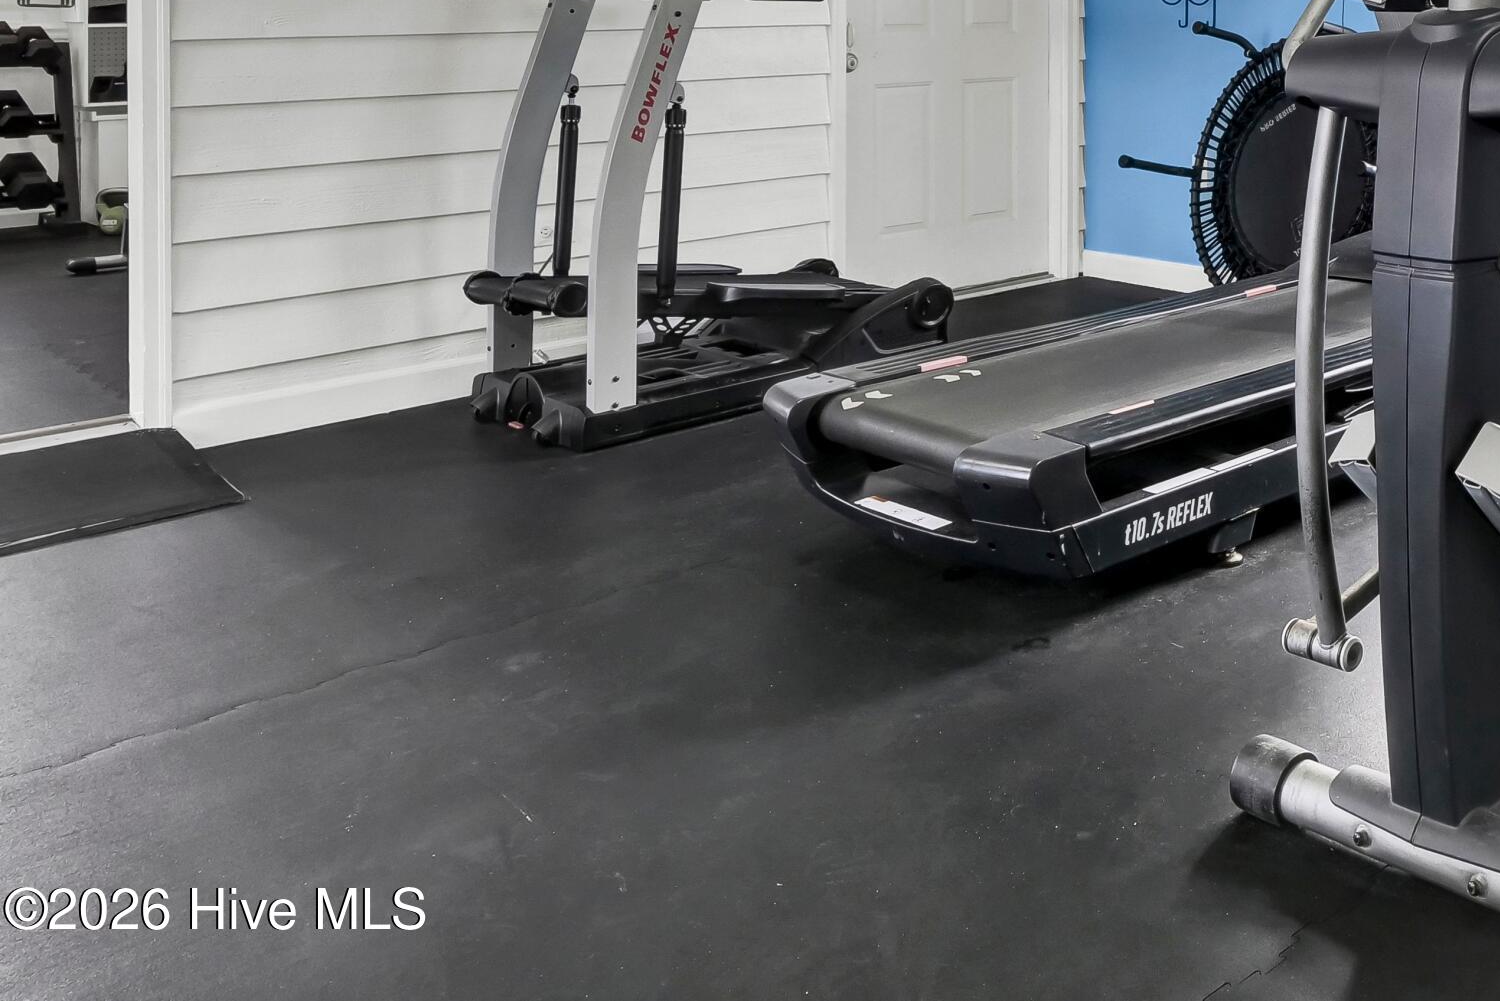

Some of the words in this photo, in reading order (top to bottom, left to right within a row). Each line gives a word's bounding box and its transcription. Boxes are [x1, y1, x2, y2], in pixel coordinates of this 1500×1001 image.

[631, 22, 680, 143] BOWFLEX
[1125, 511, 1165, 546] t10.7s
[1166, 491, 1213, 530] REFLEX
